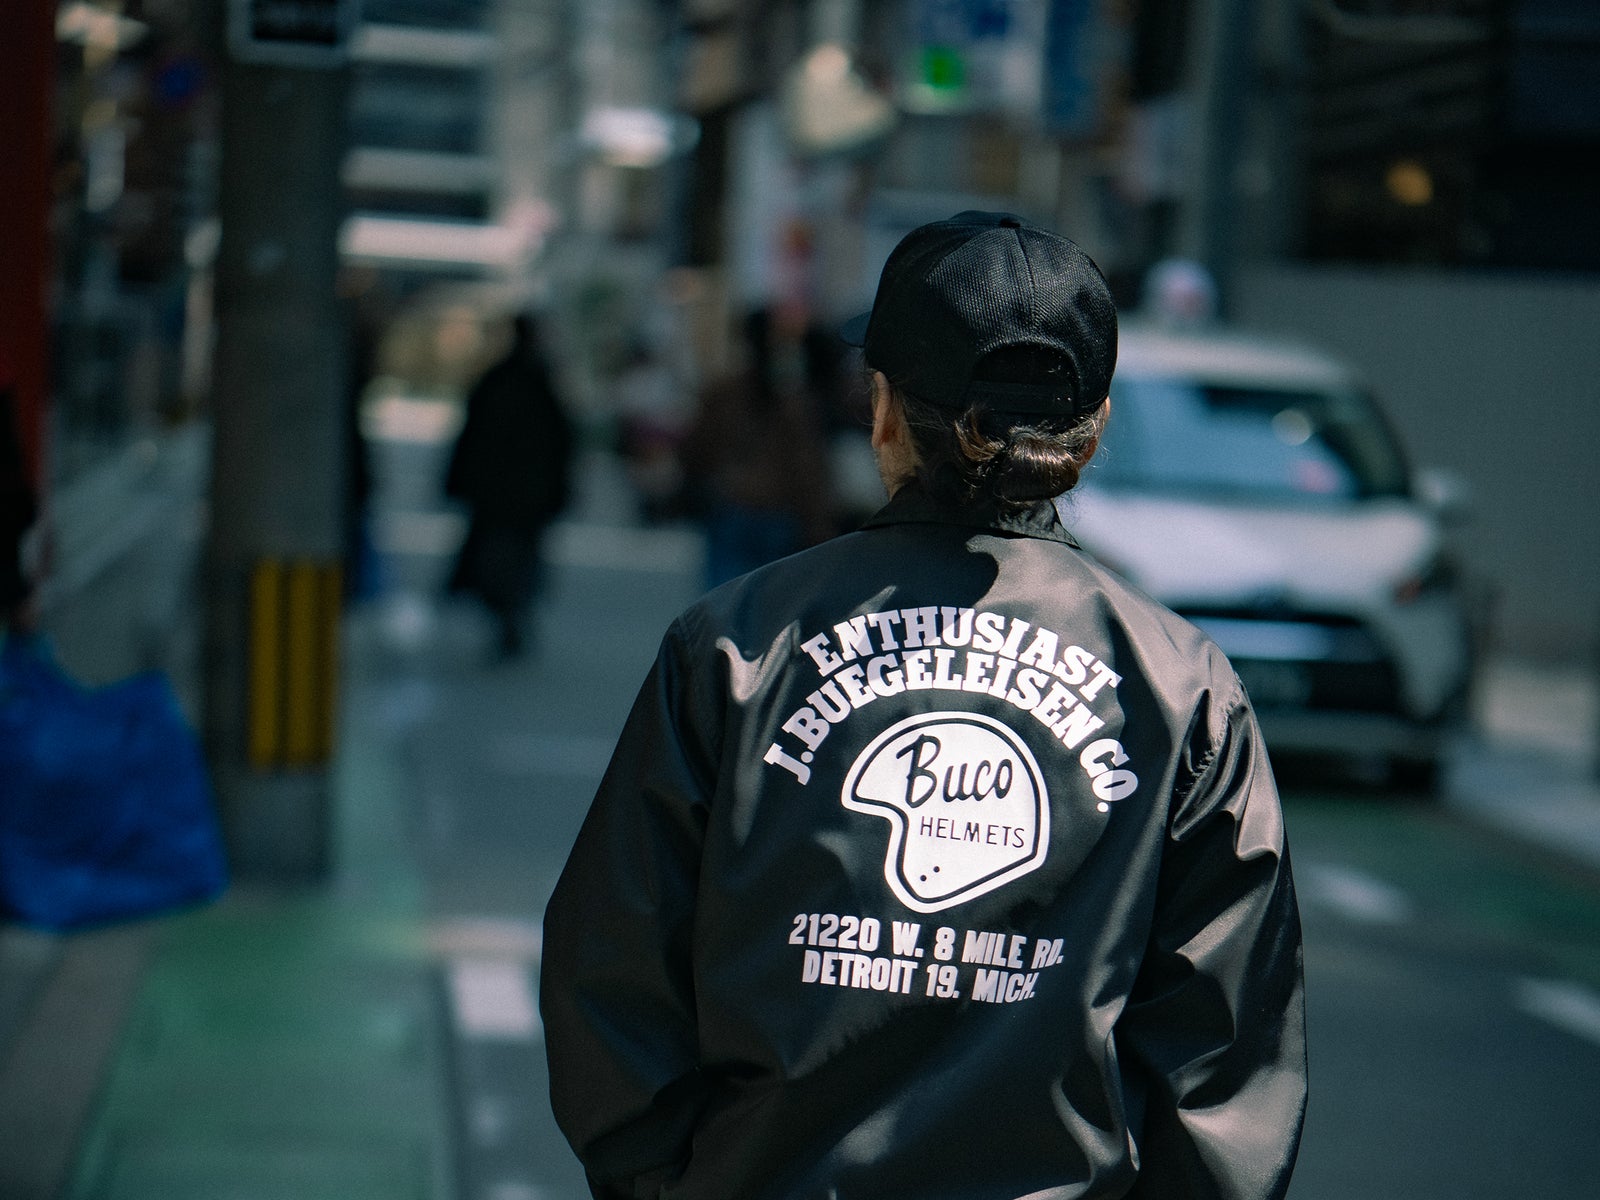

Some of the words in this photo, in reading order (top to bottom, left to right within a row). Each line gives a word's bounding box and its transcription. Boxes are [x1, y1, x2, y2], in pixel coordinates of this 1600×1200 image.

[800, 606, 1122, 701] ENTHUSIAST
[896, 734, 1013, 809] Buco
[1080, 738, 1139, 813] CO.
[920, 816, 1025, 848] HELMETS
[788, 913, 880, 951] 21220
[891, 921, 924, 958] W.
[934, 927, 956, 960] 8
[961, 930, 1027, 969] MILE
[1032, 938, 1064, 969] RD.
[802, 950, 918, 994] DETROIT
[926, 963, 959, 999] 19.
[971, 969, 1039, 1004] MICH.
